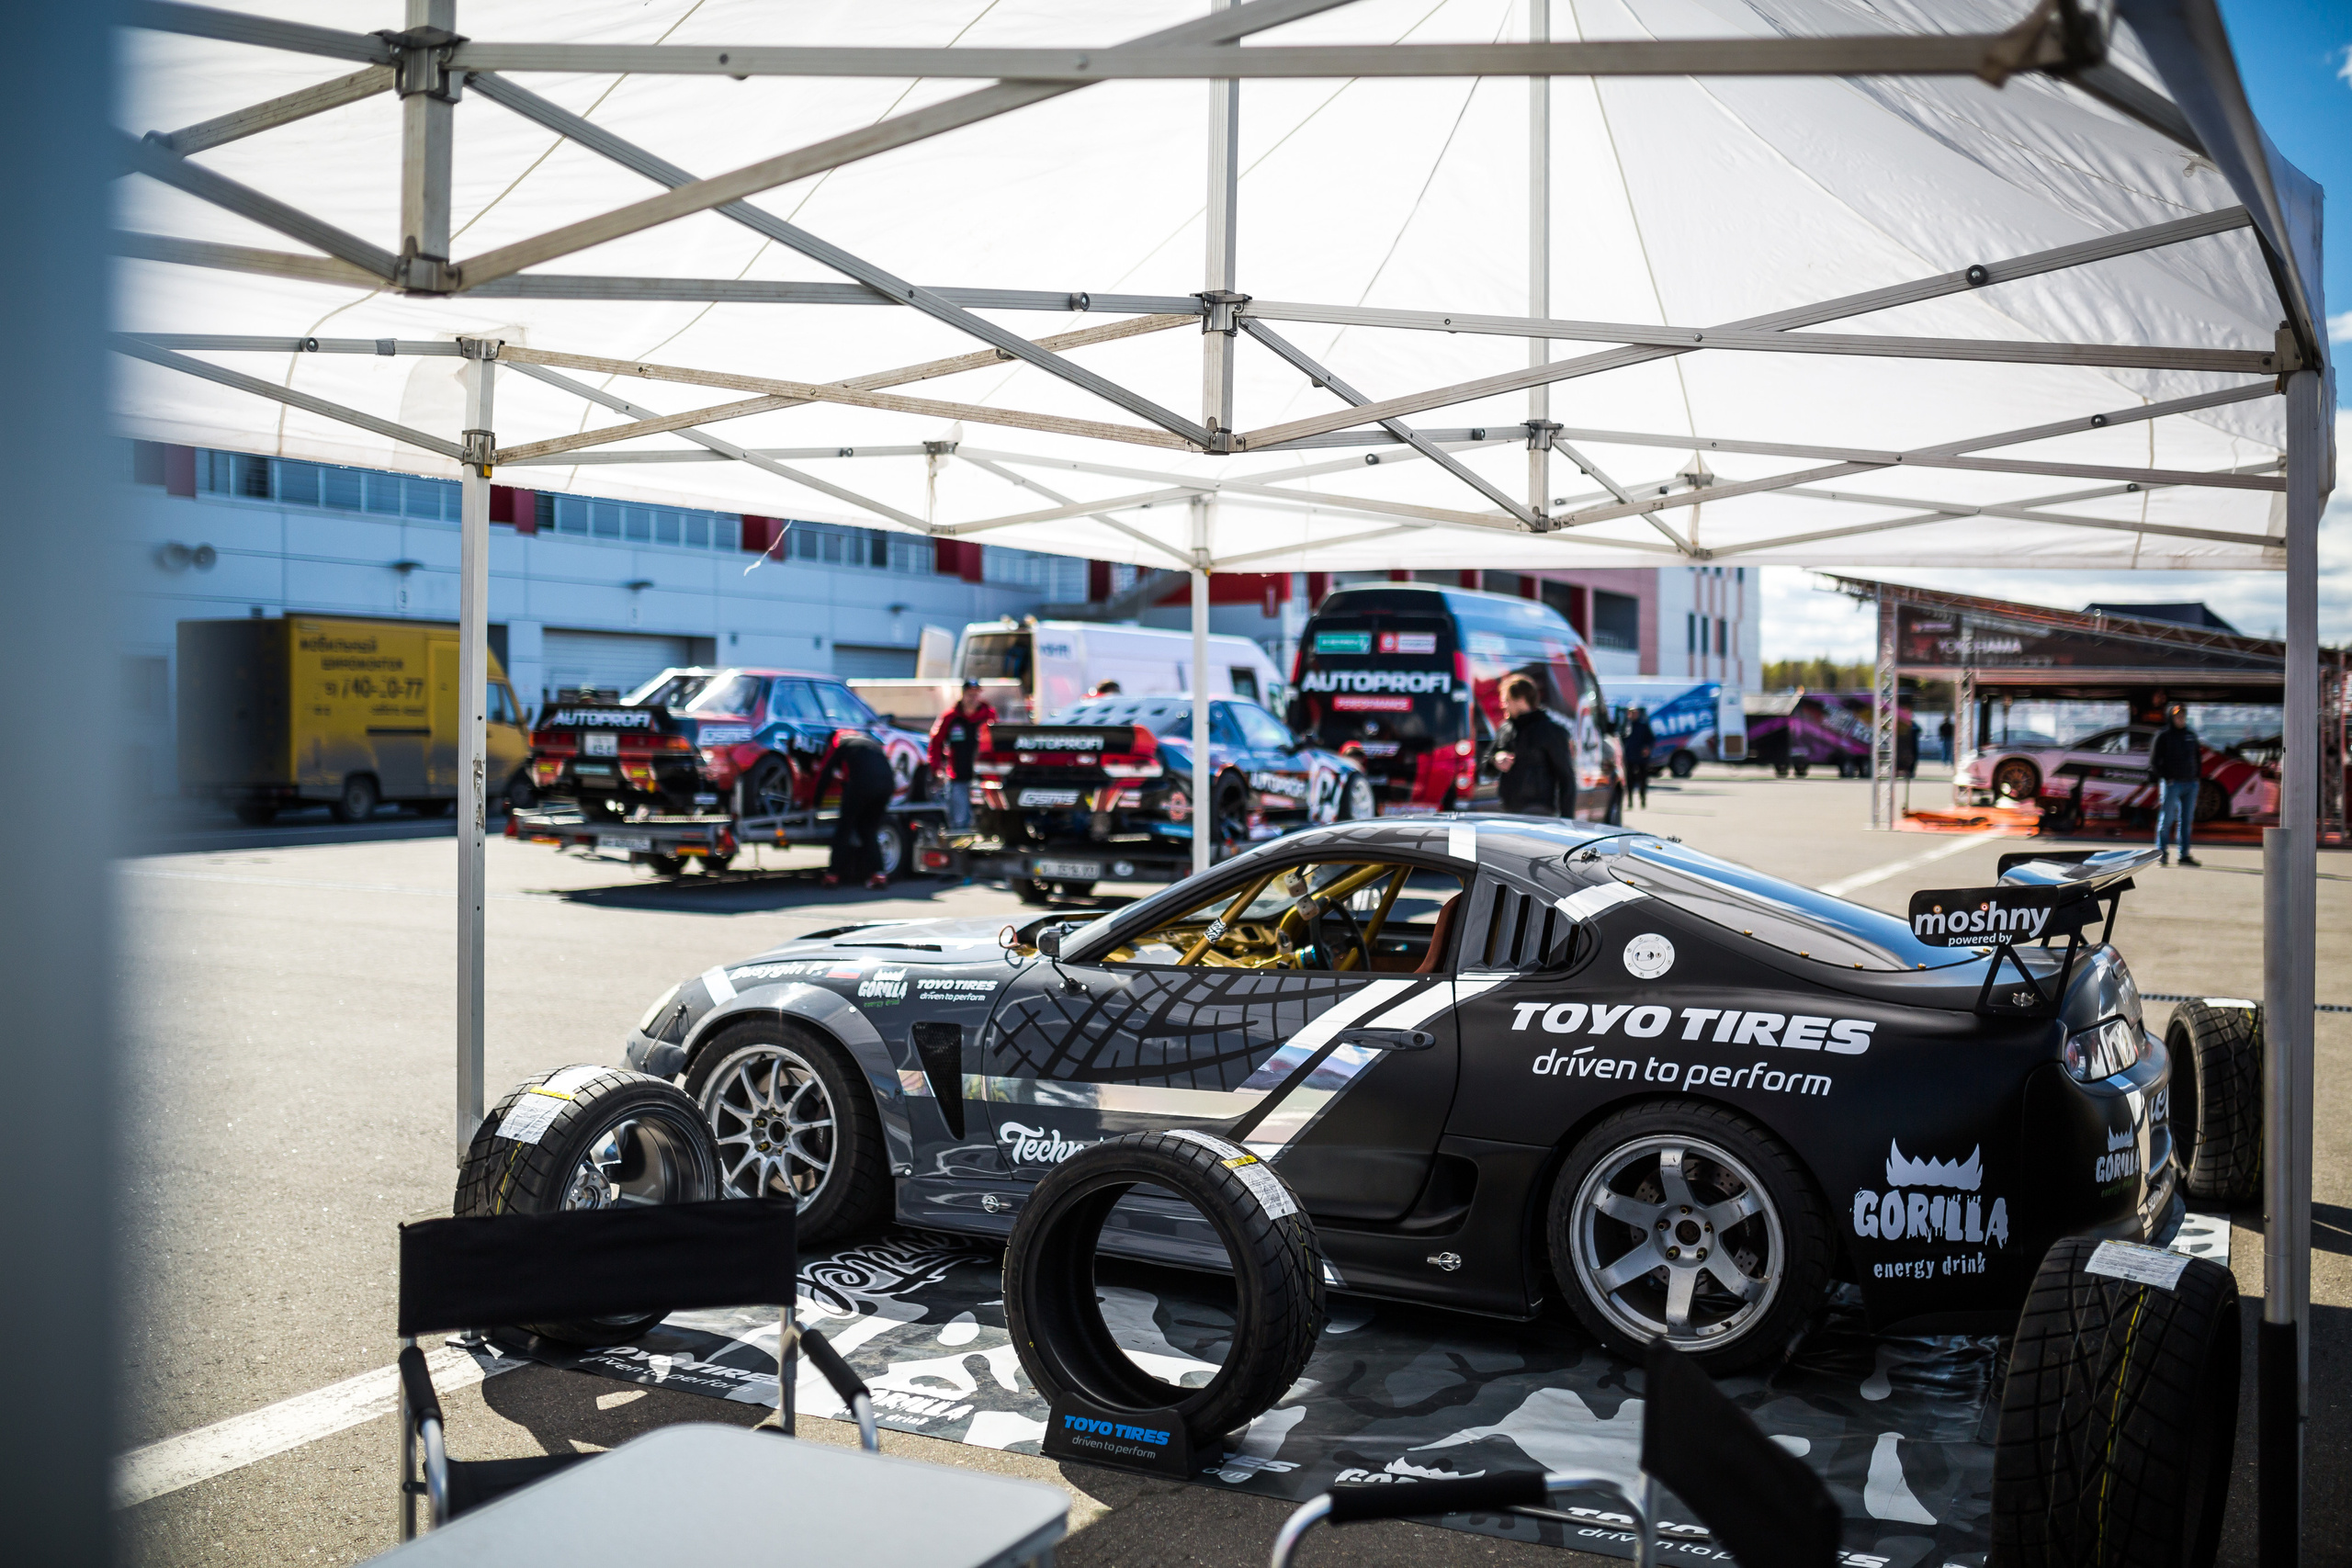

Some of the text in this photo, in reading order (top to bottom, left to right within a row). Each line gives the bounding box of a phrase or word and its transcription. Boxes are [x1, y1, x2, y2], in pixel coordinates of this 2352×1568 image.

[1300, 670, 1452, 694] AUTOPROFI
[552, 708, 651, 728] AUTOPROFI
[1013, 734, 1104, 750] AUTOPROFI
[1915, 901, 2052, 939] moshny
[1948, 932, 2012, 947] powered by
[729, 962, 805, 980] Busygin
[857, 980, 909, 999] GORILLA
[917, 979, 999, 991] TOYO TIRES
[919, 991, 944, 1000] driven
[953, 993, 986, 1002] perform
[1511, 1002, 1877, 1055] TOYO TIRES
[1532, 1045, 1832, 1096] driven to perform
[2096, 1148, 2141, 1183] GORILLA
[1849, 1188, 2009, 1249] GORILLA
[1873, 1251, 1986, 1279] energy drink
[667, 1372, 754, 1393] perform
[871, 1388, 975, 1421] ORILLA
[1064, 1415, 1170, 1447] TOYO TIRES
[1071, 1435, 1157, 1460] driven to perform
[1679, 1543, 1712, 1555] to
